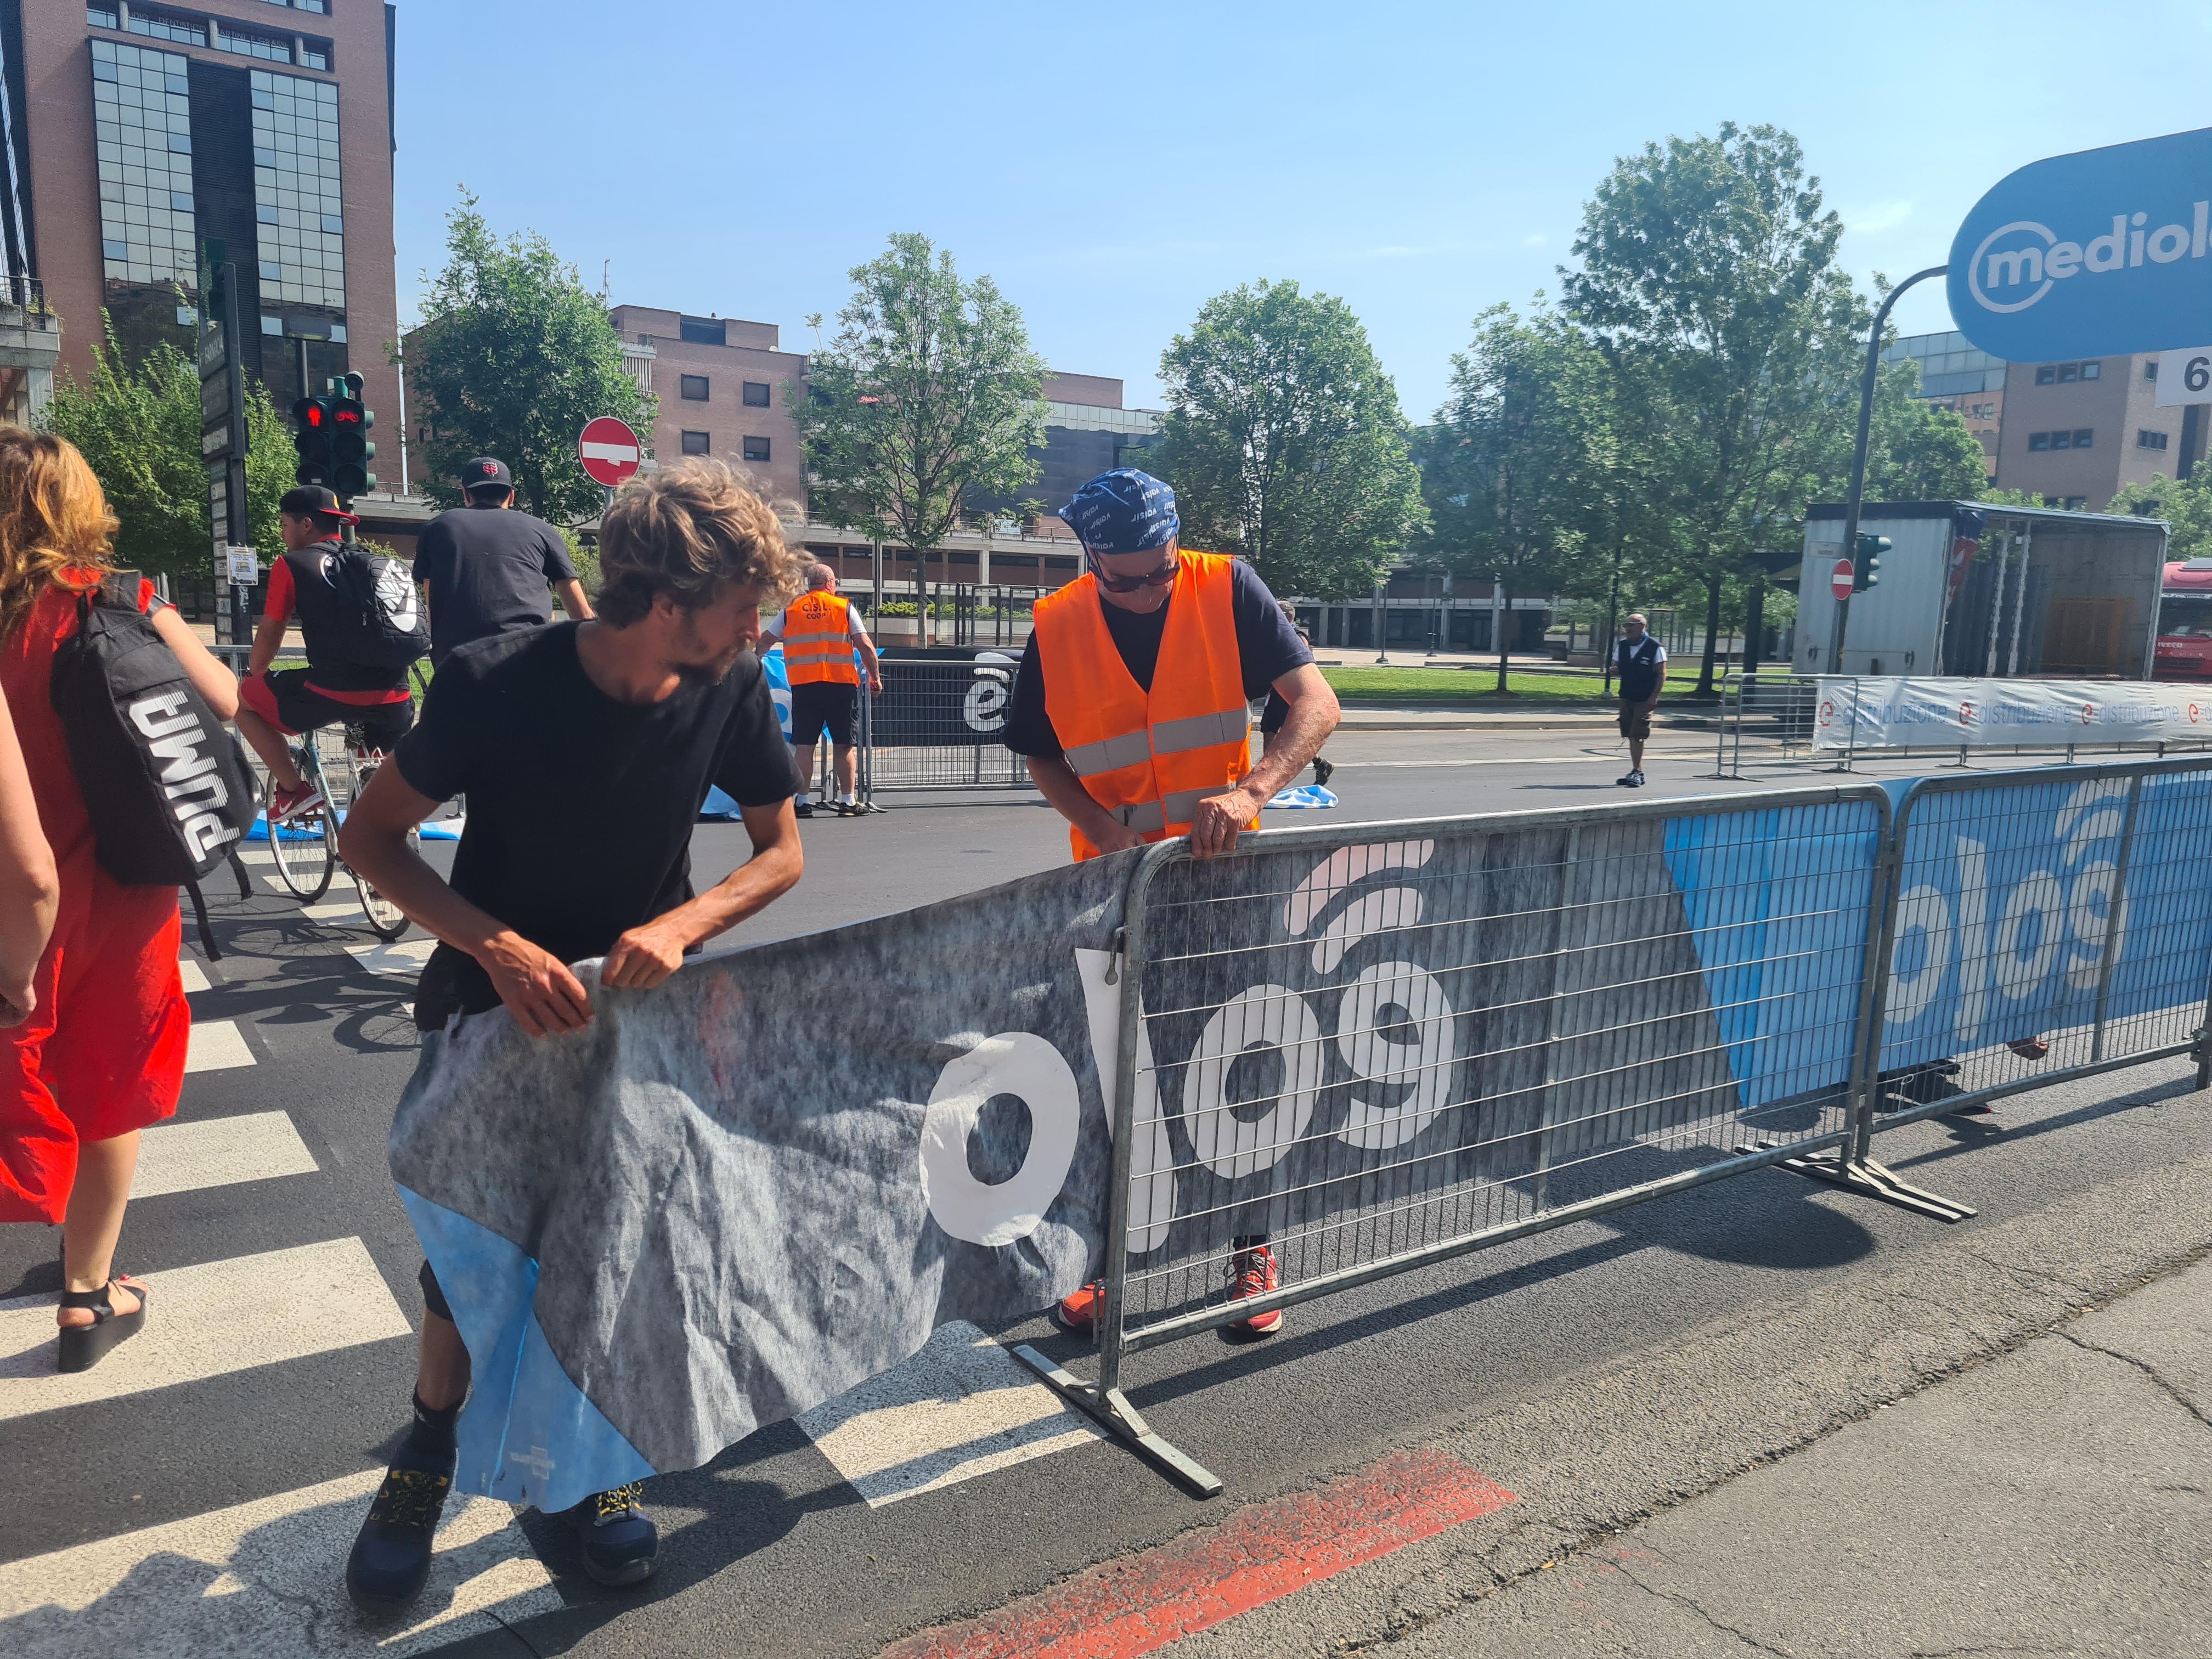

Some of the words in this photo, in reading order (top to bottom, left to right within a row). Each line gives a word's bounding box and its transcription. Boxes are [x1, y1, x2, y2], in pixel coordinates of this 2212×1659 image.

[128, 12, 149, 20] UDIO
[218, 29, 246, 40] ARTINI
[1986, 200, 2212, 290] mediol
[1131, 507, 1157, 523] valsir
[128, 689, 240, 862] PUMA
